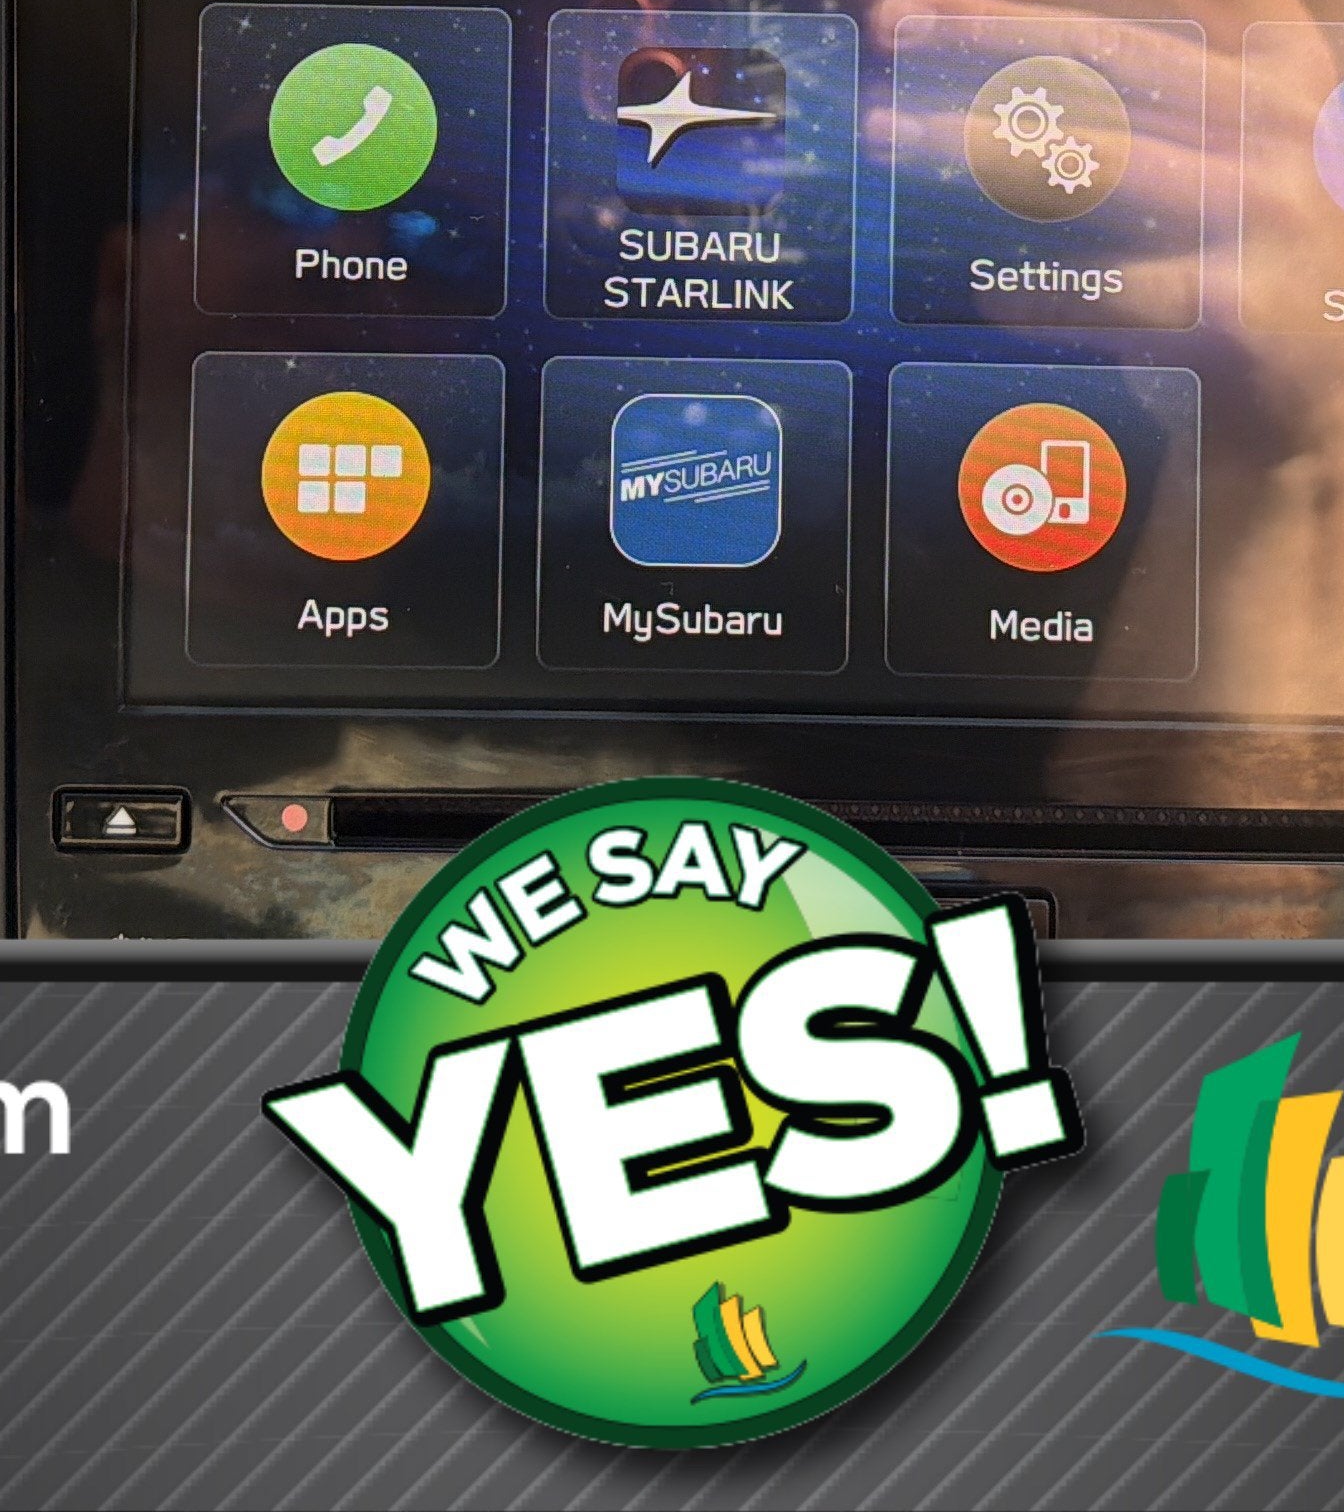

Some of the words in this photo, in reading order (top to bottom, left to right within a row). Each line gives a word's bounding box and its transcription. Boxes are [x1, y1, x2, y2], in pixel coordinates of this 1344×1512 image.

[619, 229, 781, 264] SUBARU
[294, 248, 409, 282] Phone
[970, 259, 1124, 302] Settings
[604, 277, 795, 311] STARLINK
[297, 599, 390, 639] Apps
[602, 602, 784, 643] MySubaru
[989, 609, 1094, 644] Media
